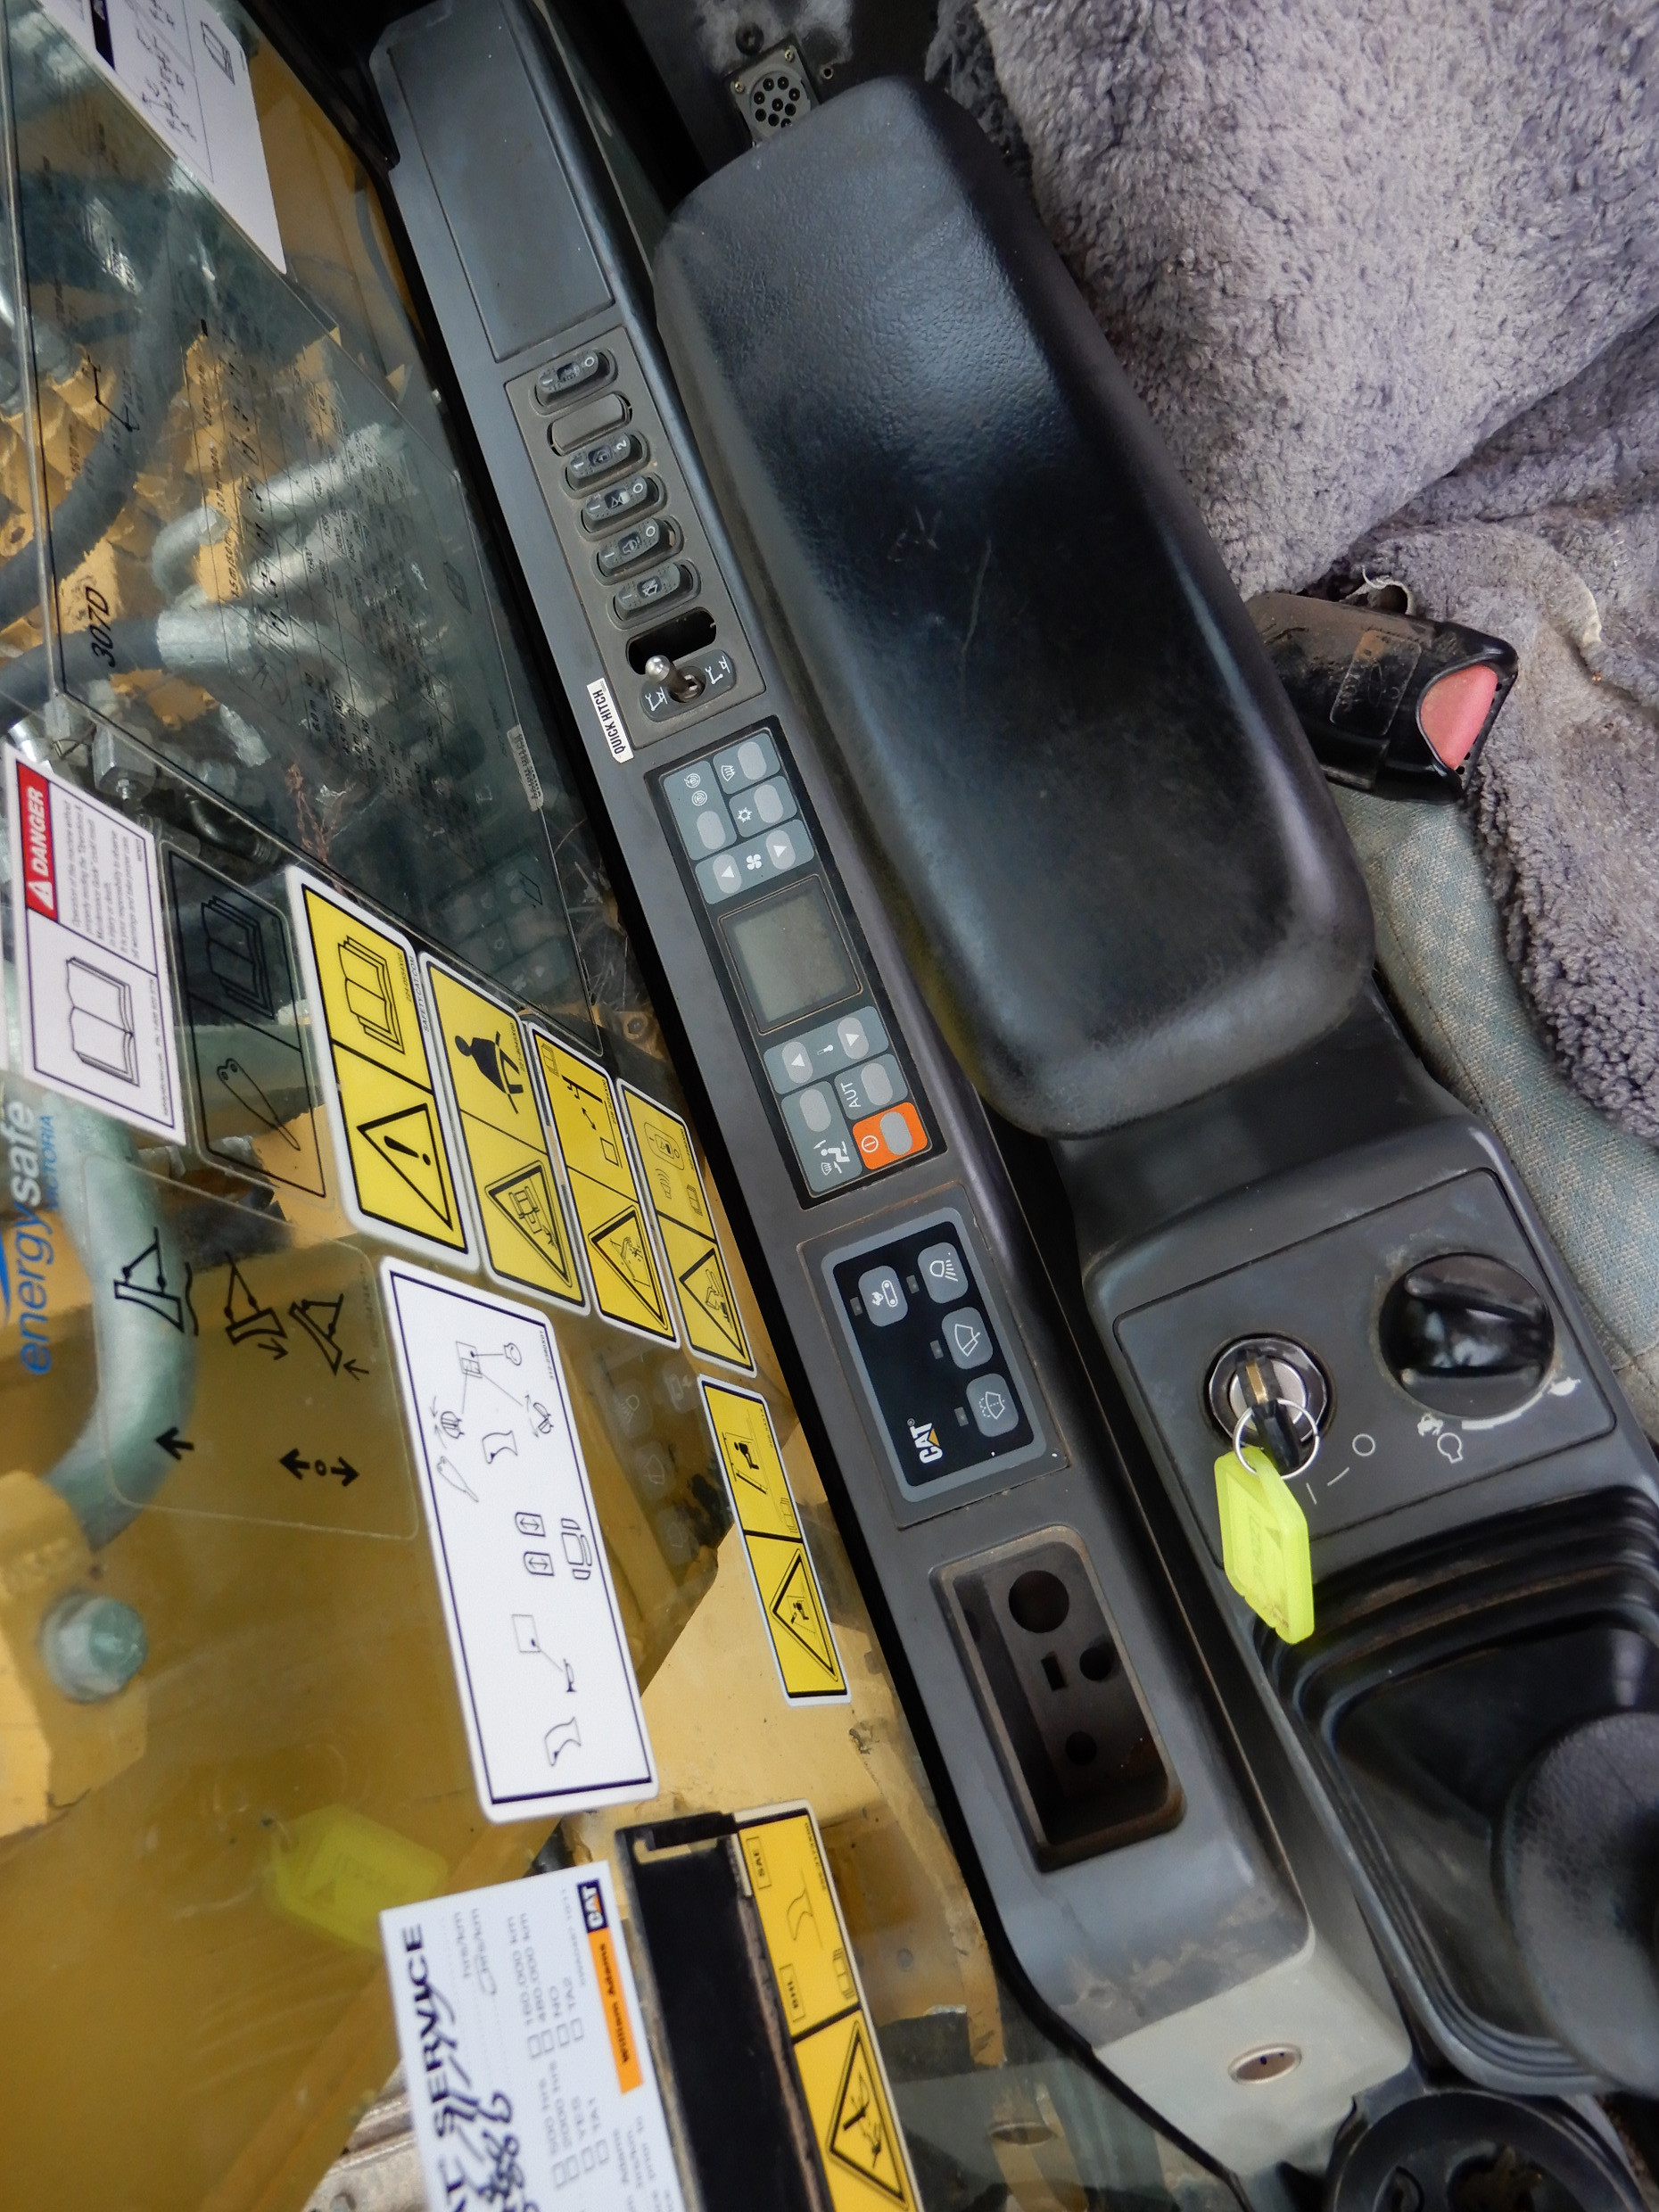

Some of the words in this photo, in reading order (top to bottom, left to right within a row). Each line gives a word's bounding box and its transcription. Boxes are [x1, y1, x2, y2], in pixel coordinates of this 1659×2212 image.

[85, 584, 116, 669] 307D
[592, 689, 613, 722] HITCH
[605, 722, 626, 755] QUICK
[26, 782, 50, 879] DANGER
[69, 886, 81, 929] Operation
[40, 1115, 59, 1209] VICTORIA
[2, 1101, 54, 1374] energysafe
[912, 1423, 944, 1464] CAT
[579, 1883, 606, 1929] CAT
[596, 1943, 617, 1997] Adams
[398, 1924, 458, 2137] SERVICE
[607, 2001, 631, 2064] William
